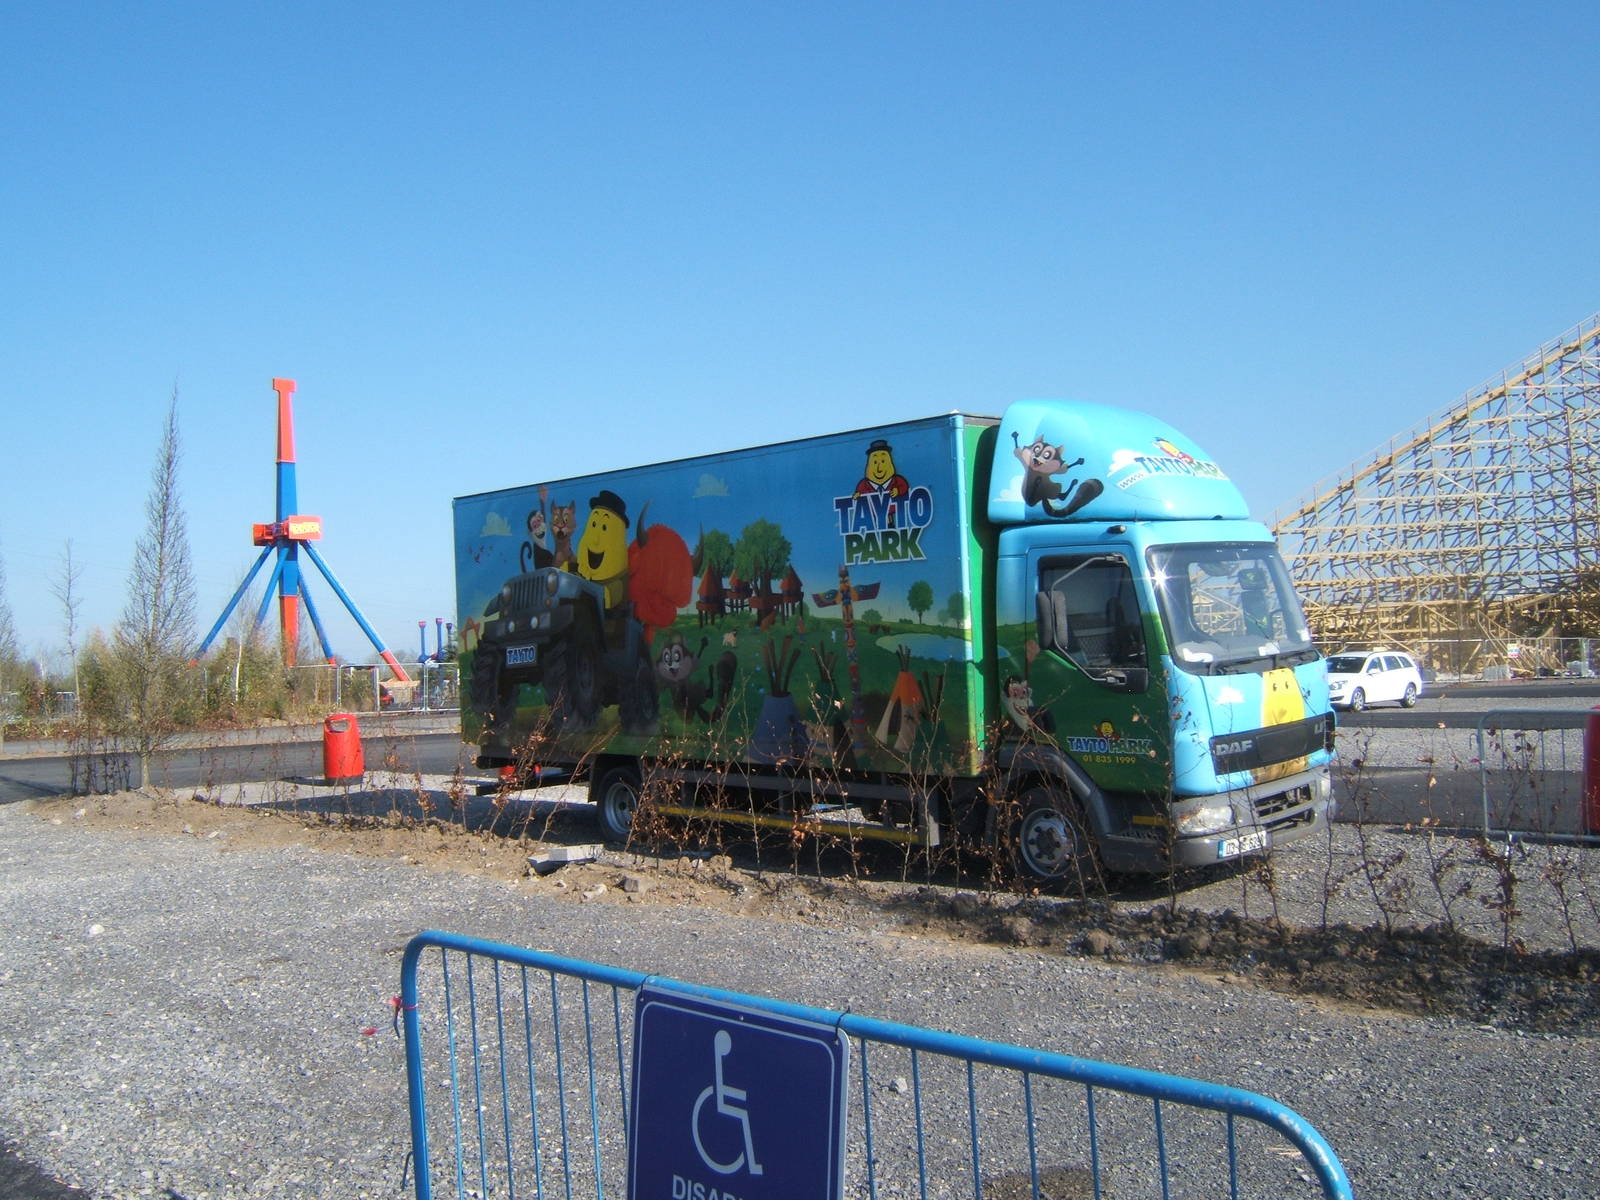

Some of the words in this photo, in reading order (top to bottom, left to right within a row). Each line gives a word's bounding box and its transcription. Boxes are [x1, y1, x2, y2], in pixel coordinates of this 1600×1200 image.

[833, 486, 933, 536] TAYTO
[844, 527, 927, 565] PARK
[506, 646, 535, 664] TAYTO
[1215, 740, 1253, 755] DAF
[672, 1174, 744, 1200] DISA
